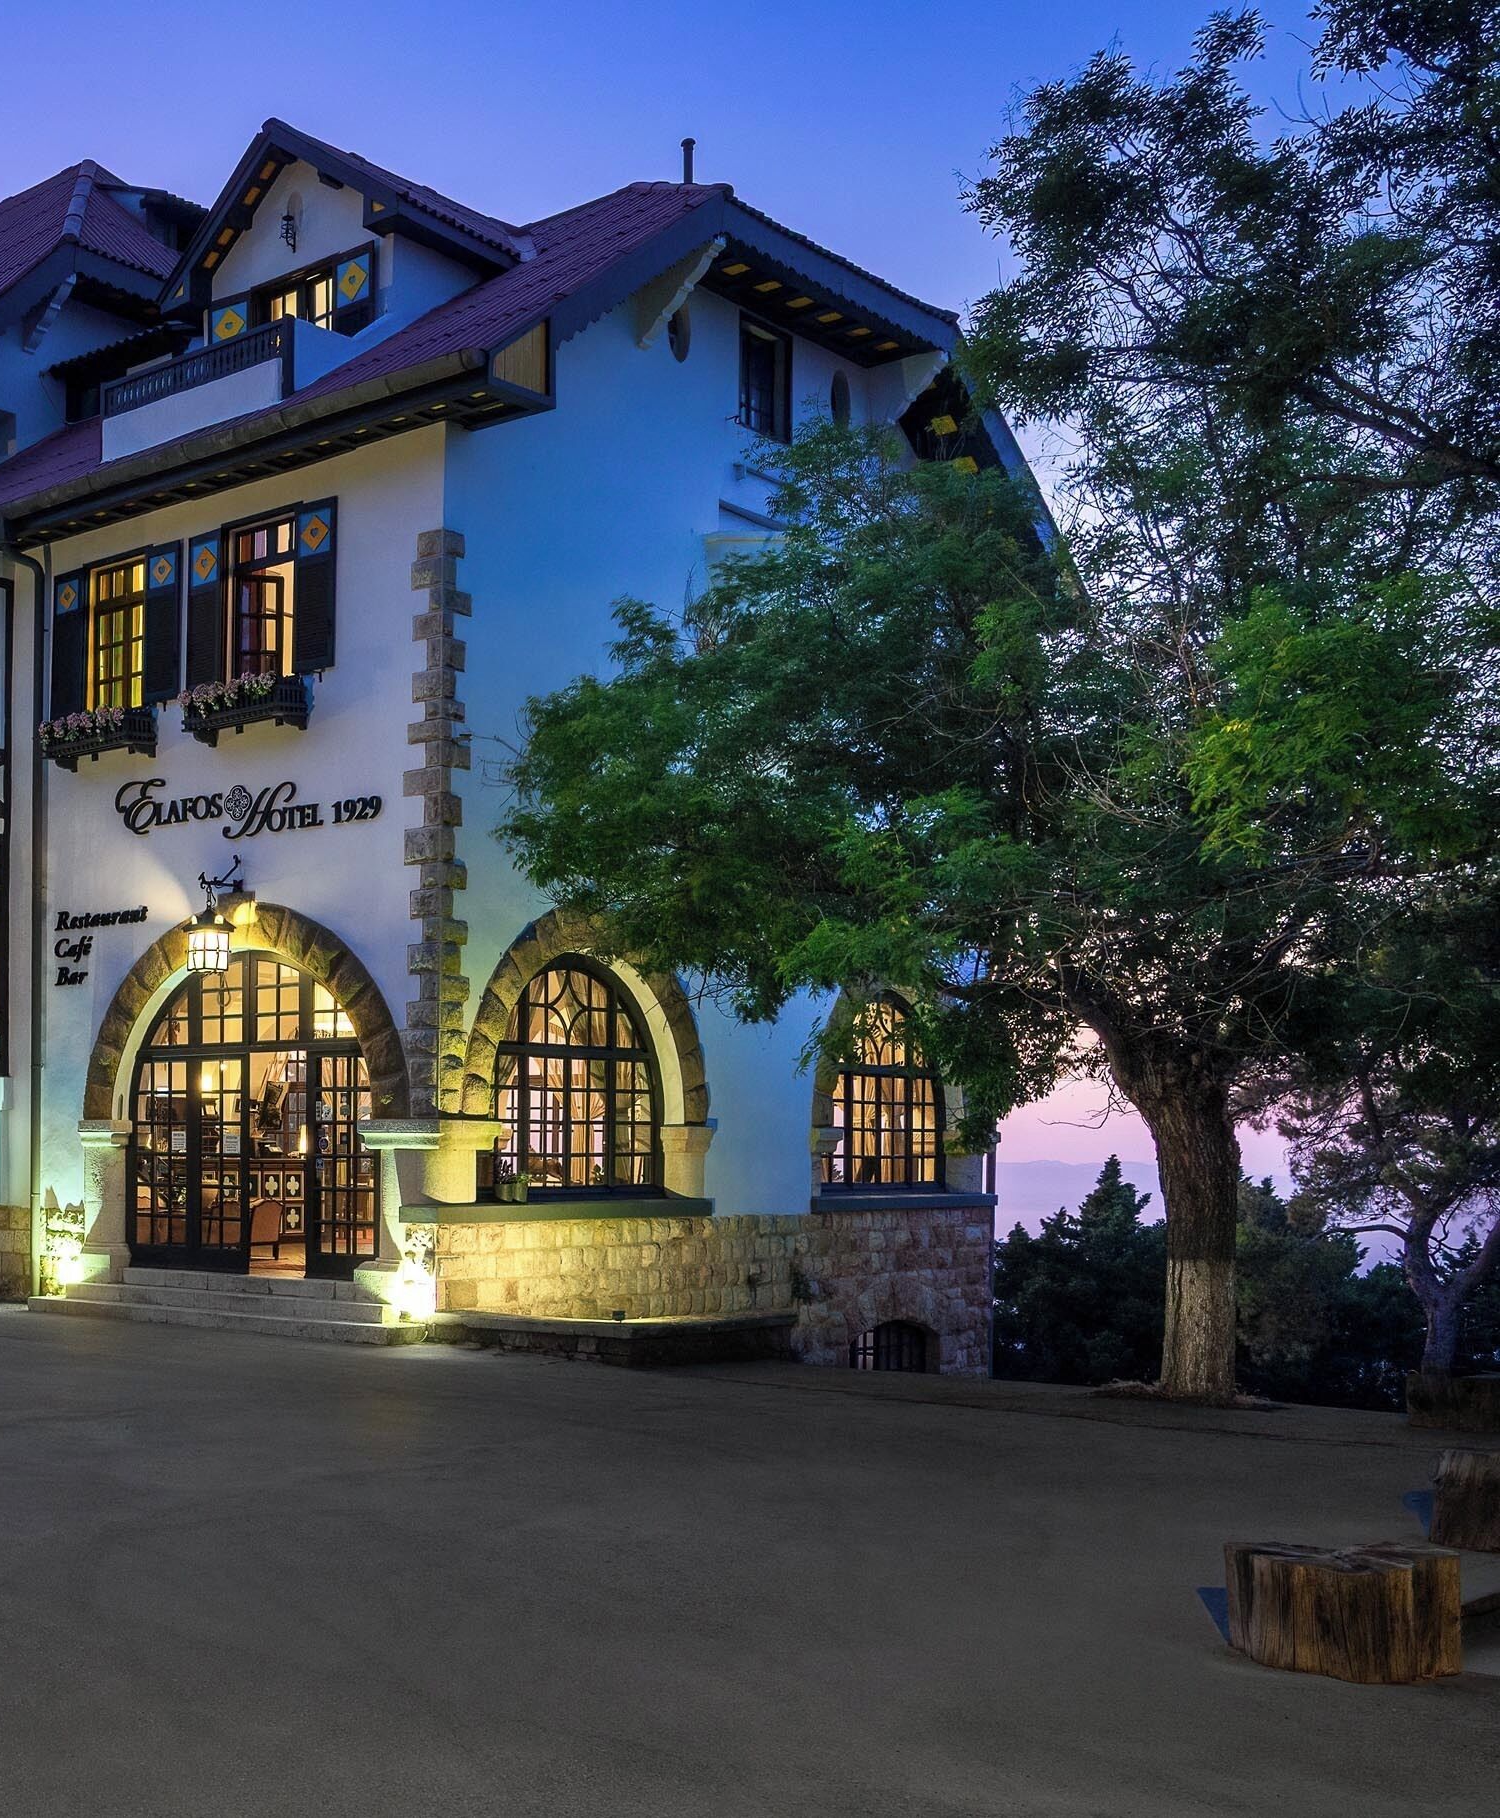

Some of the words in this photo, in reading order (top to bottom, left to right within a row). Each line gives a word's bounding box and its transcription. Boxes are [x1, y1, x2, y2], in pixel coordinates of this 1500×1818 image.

[115, 778, 223, 834] ELAFOS
[222, 781, 324, 839] HOTEL
[331, 795, 382, 824] 1929
[54, 905, 148, 931] Restaurant
[54, 935, 93, 963] Café
[54, 966, 88, 986] Bar
